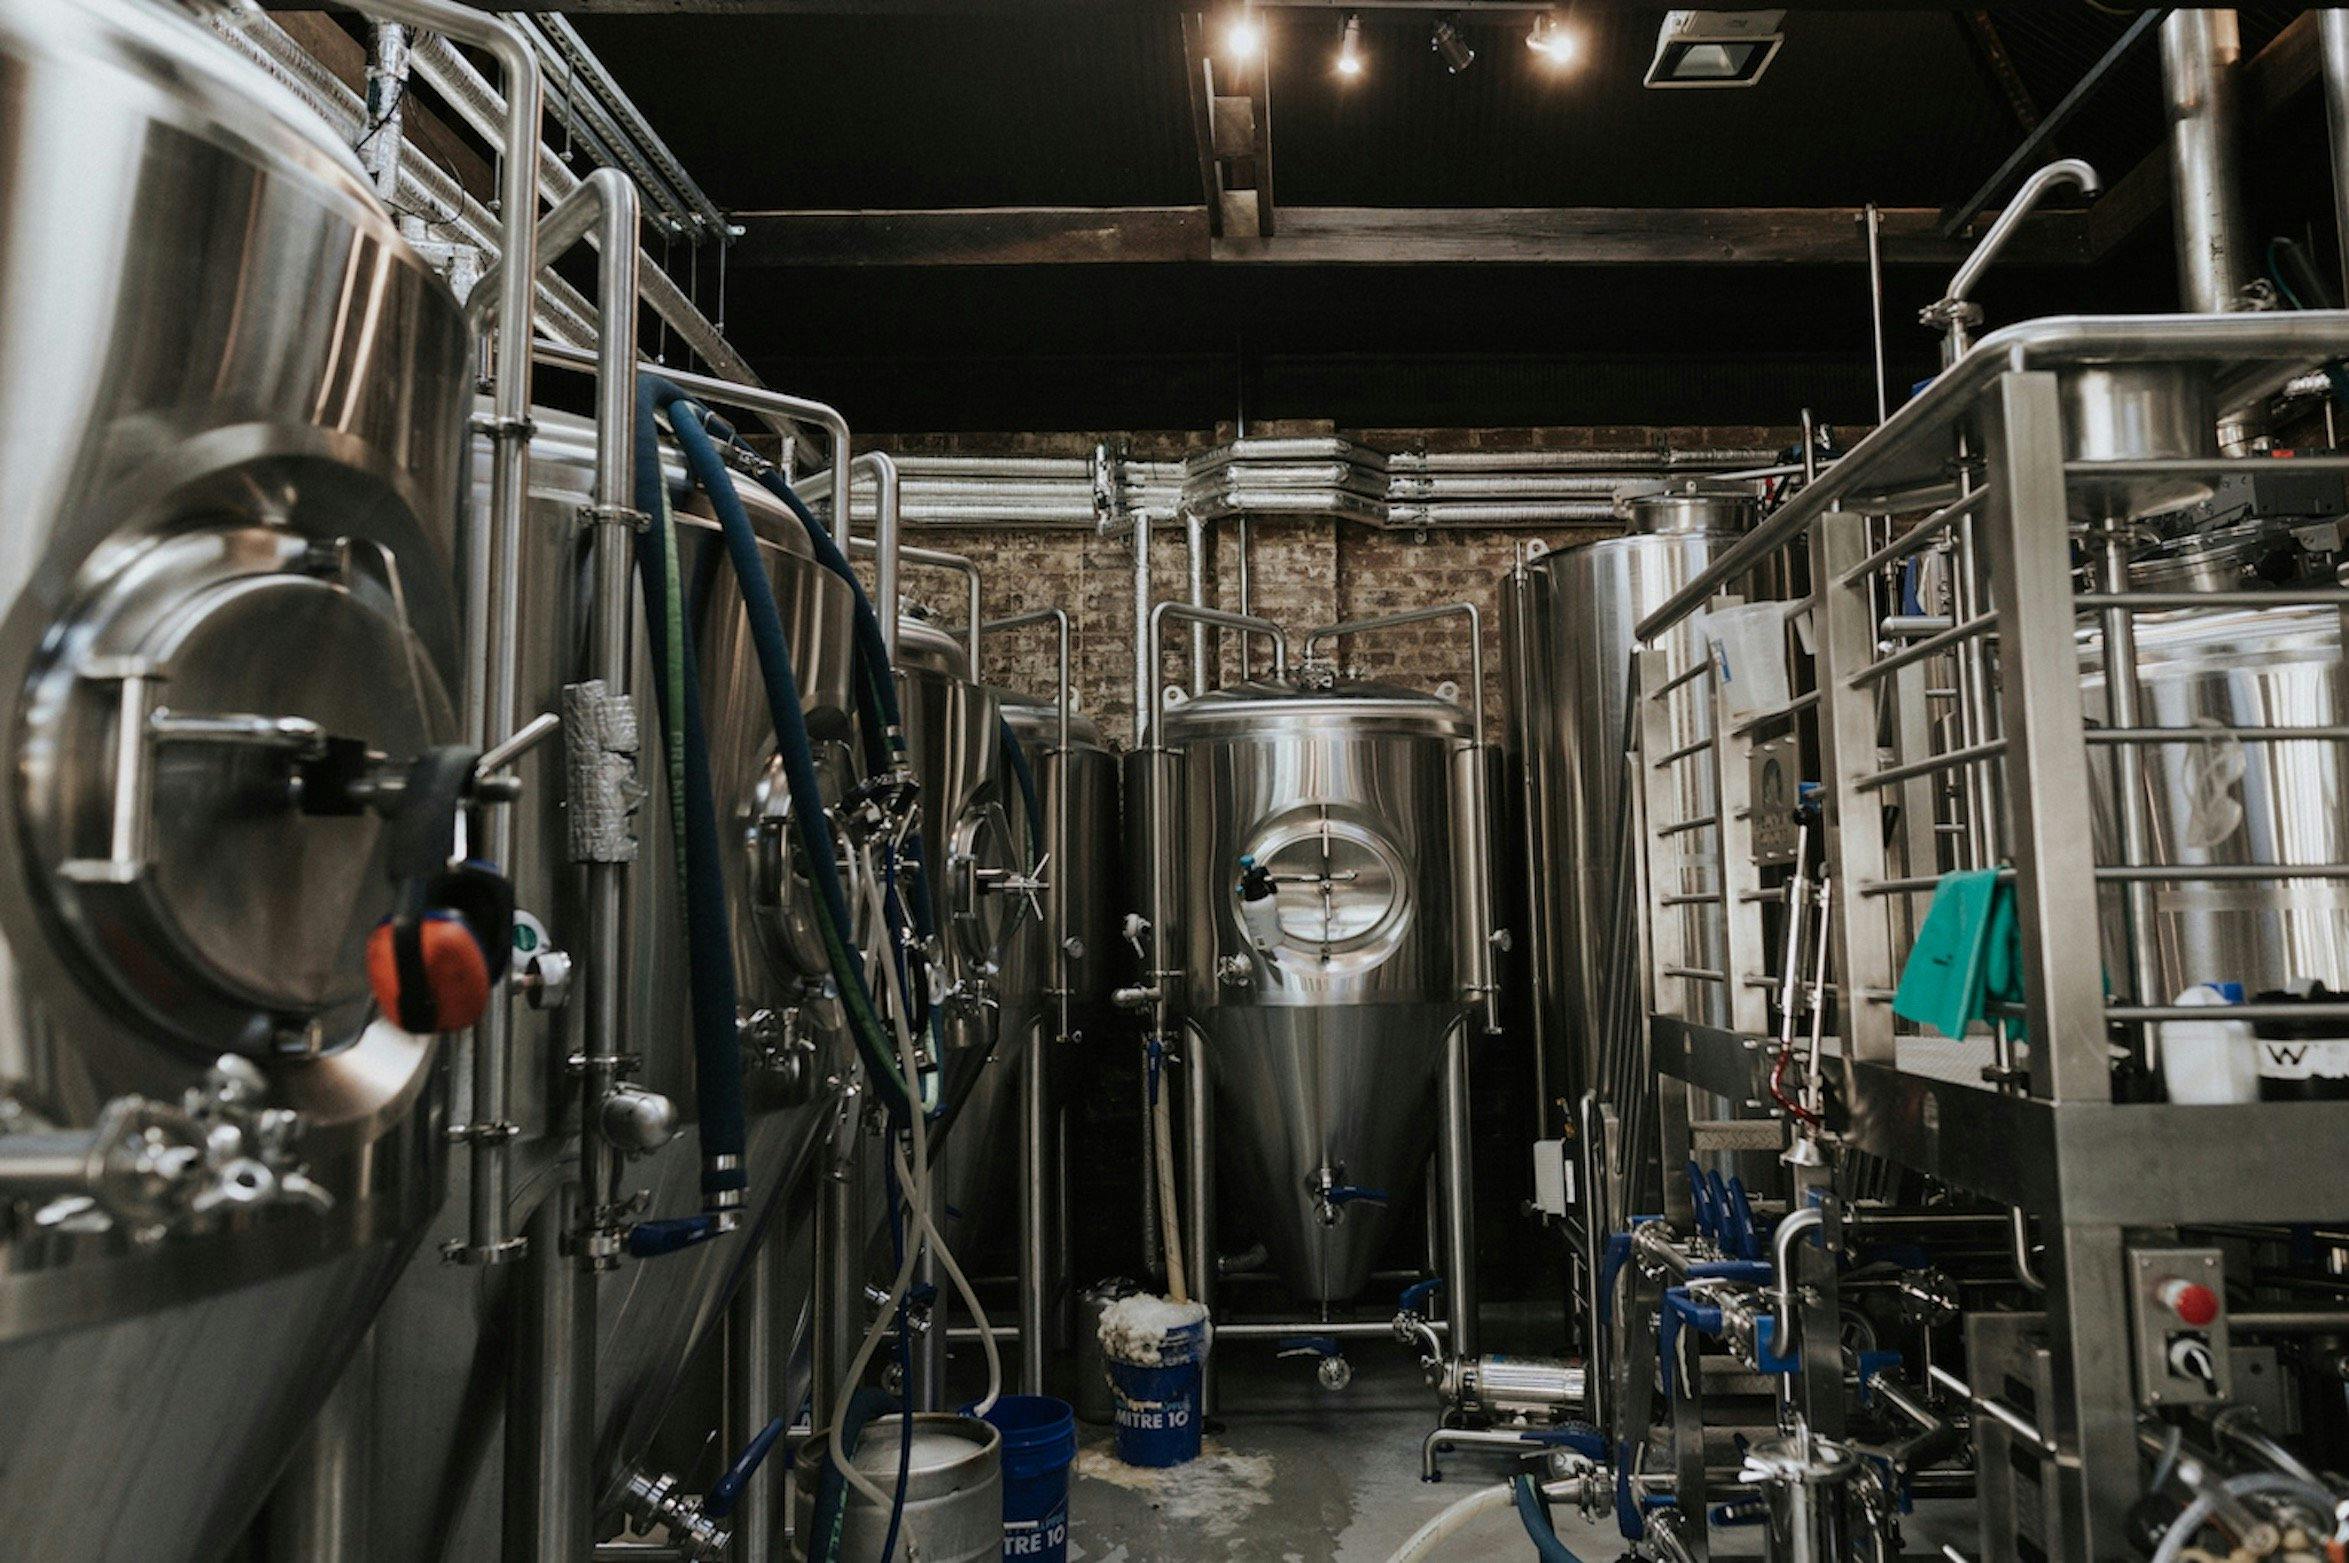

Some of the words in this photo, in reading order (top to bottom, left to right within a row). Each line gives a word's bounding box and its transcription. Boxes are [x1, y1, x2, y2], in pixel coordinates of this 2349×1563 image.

[2267, 1044, 2308, 1066] W
[1115, 1408, 1163, 1430] MITRE
[1168, 1410, 1189, 1428] 10
[1003, 1532, 1042, 1556] TRE
[1047, 1524, 1066, 1548] 10
